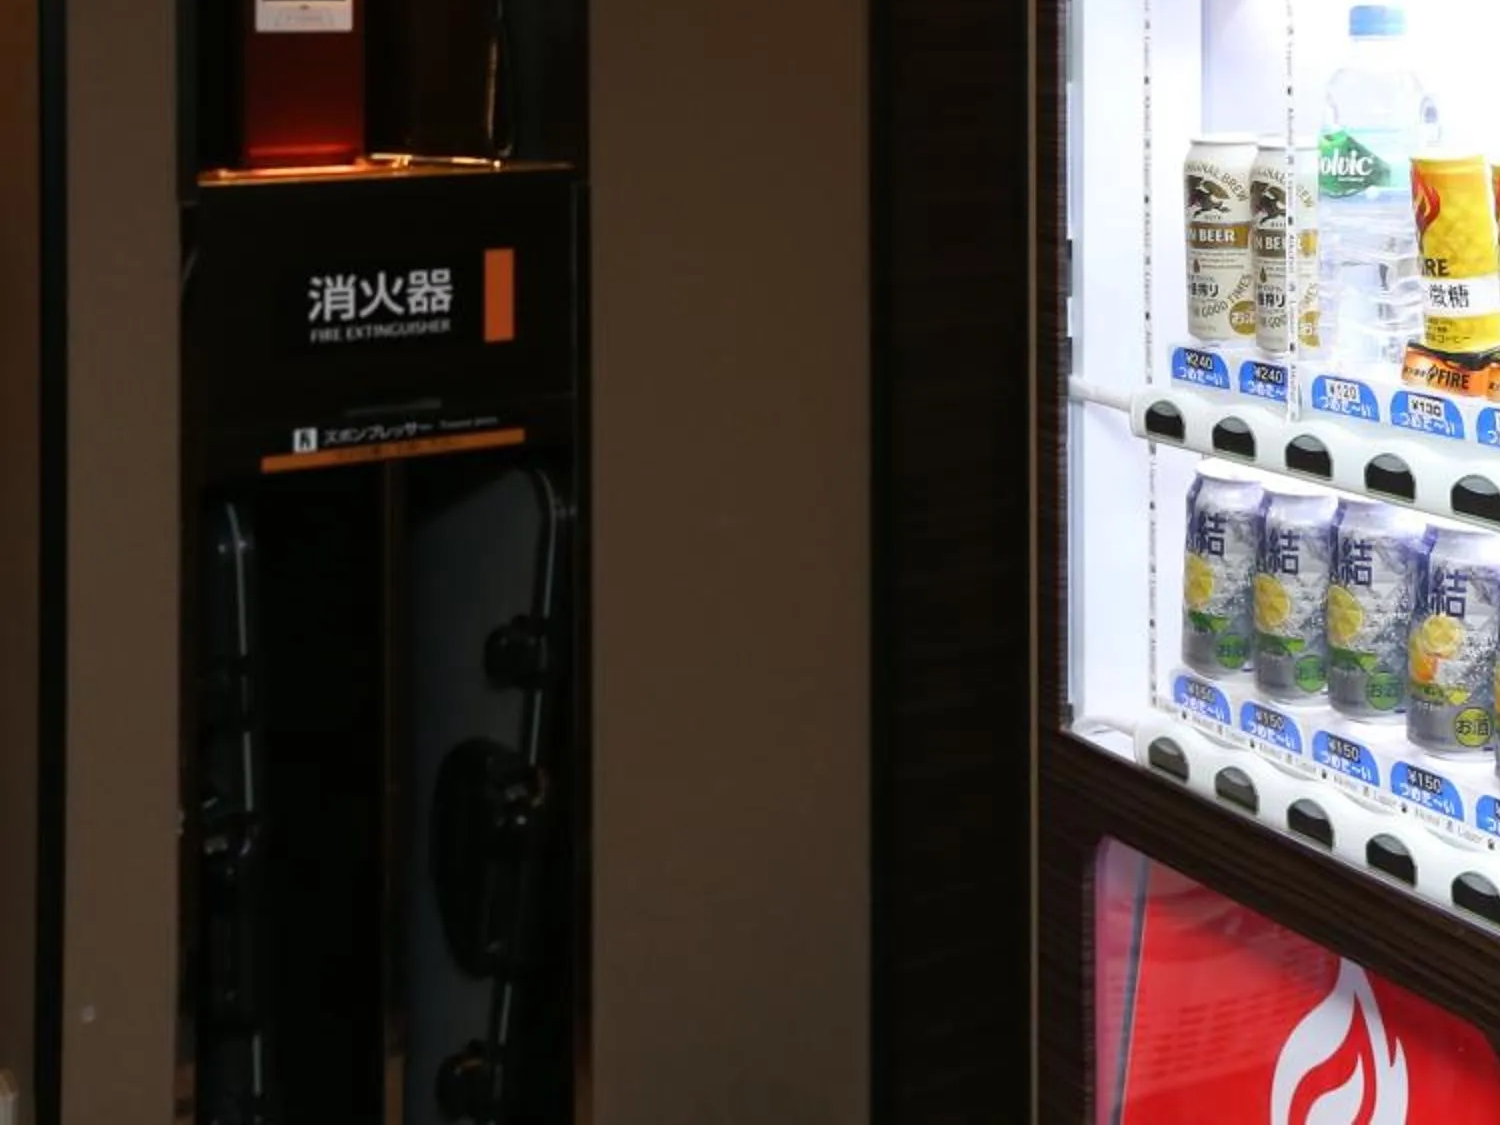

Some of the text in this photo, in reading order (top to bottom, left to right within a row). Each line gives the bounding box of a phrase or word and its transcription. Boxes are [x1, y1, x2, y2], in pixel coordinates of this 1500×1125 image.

[1320, 148, 1373, 176] olvic
[1199, 228, 1235, 242] BEER
[1422, 258, 1450, 277] RE
[308, 268, 454, 322] 消火器
[1429, 283, 1470, 308] 微糖
[310, 319, 451, 344] FIRE EXTINGUISHER
[1185, 351, 1213, 371] ¥240
[1254, 363, 1283, 383] ¥240
[1438, 369, 1470, 390] FIRE
[1411, 401, 1442, 416] ¥130
[1408, 768, 1442, 792] ¥150
